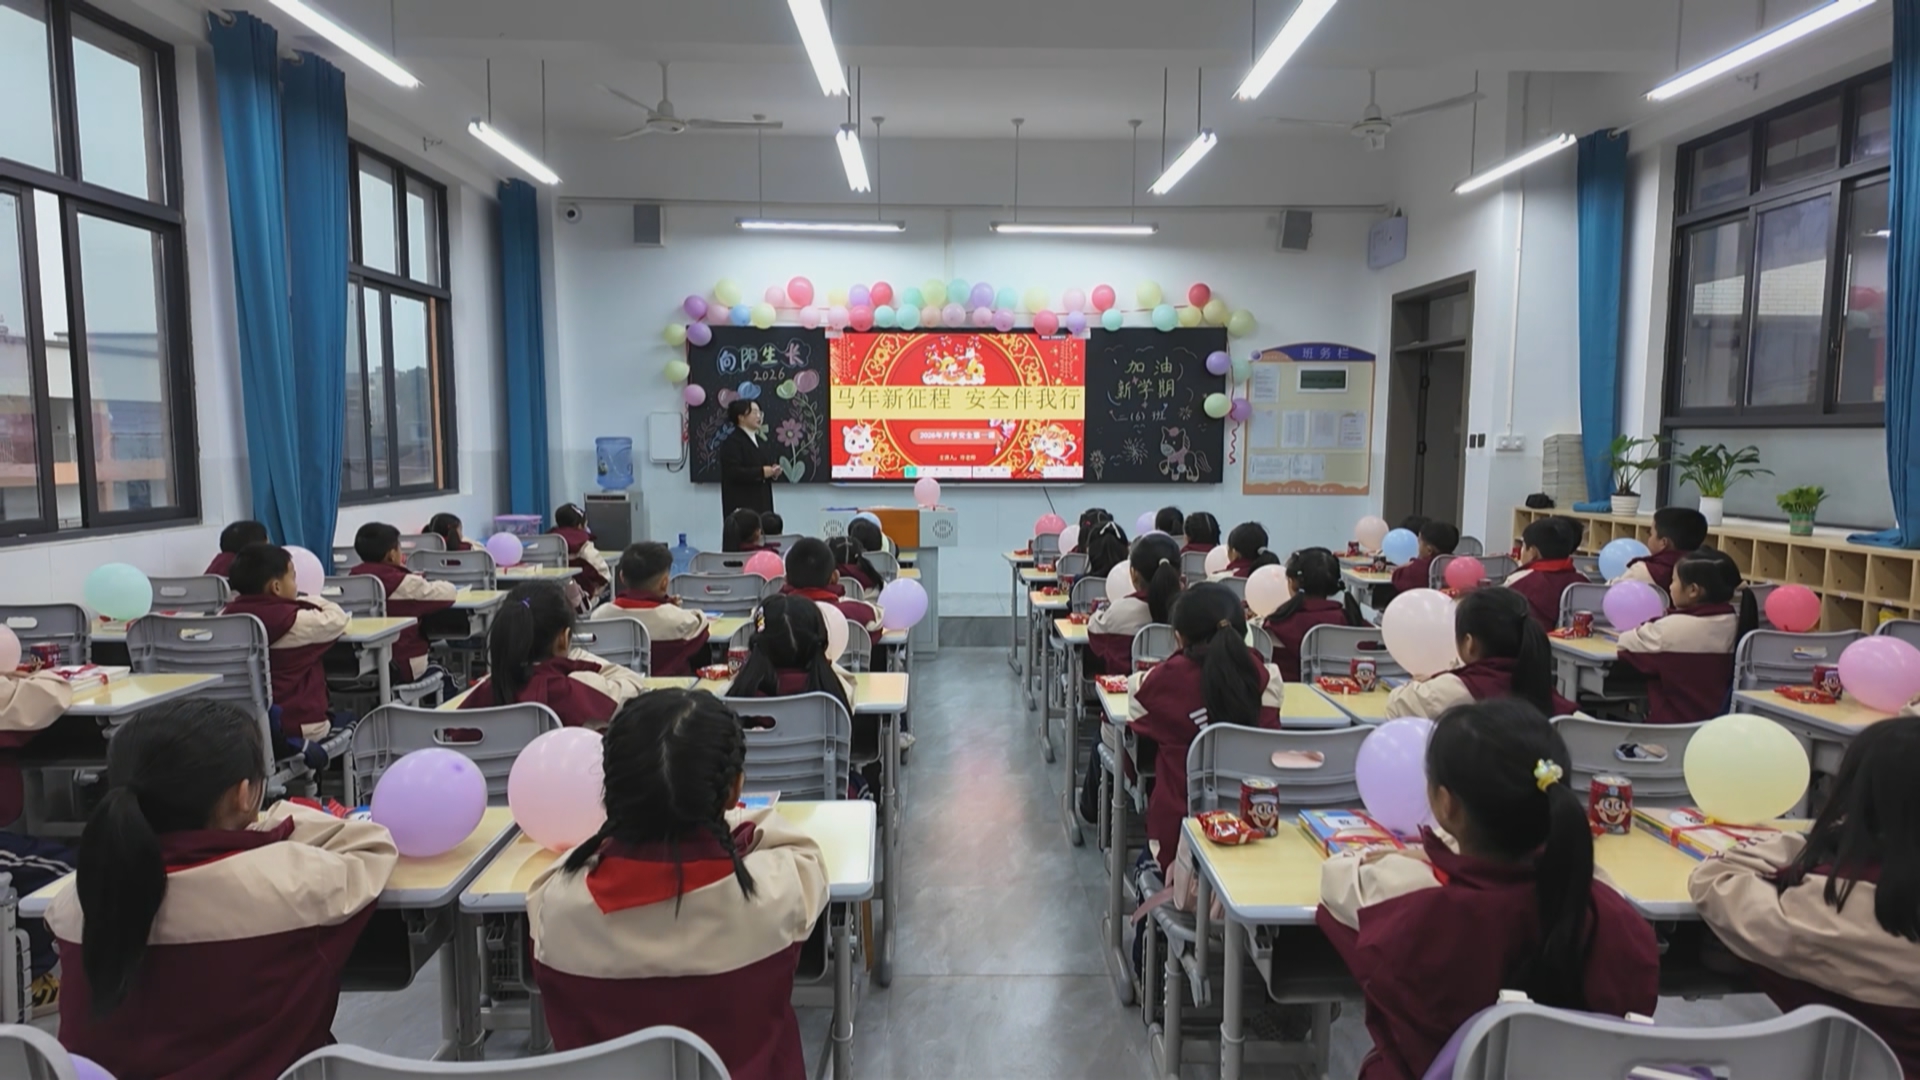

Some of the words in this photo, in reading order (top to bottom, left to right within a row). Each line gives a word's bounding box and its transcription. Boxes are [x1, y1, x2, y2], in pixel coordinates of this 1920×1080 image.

[720, 343, 804, 371] 向阳生长
[1302, 347, 1349, 359] 班务栏
[754, 367, 785, 381] 2026
[1124, 356, 1173, 375] 加油
[836, 387, 951, 409] 马年新征程
[965, 387, 1080, 410] 安全伴我行
[1115, 378, 1174, 400] 新学期
